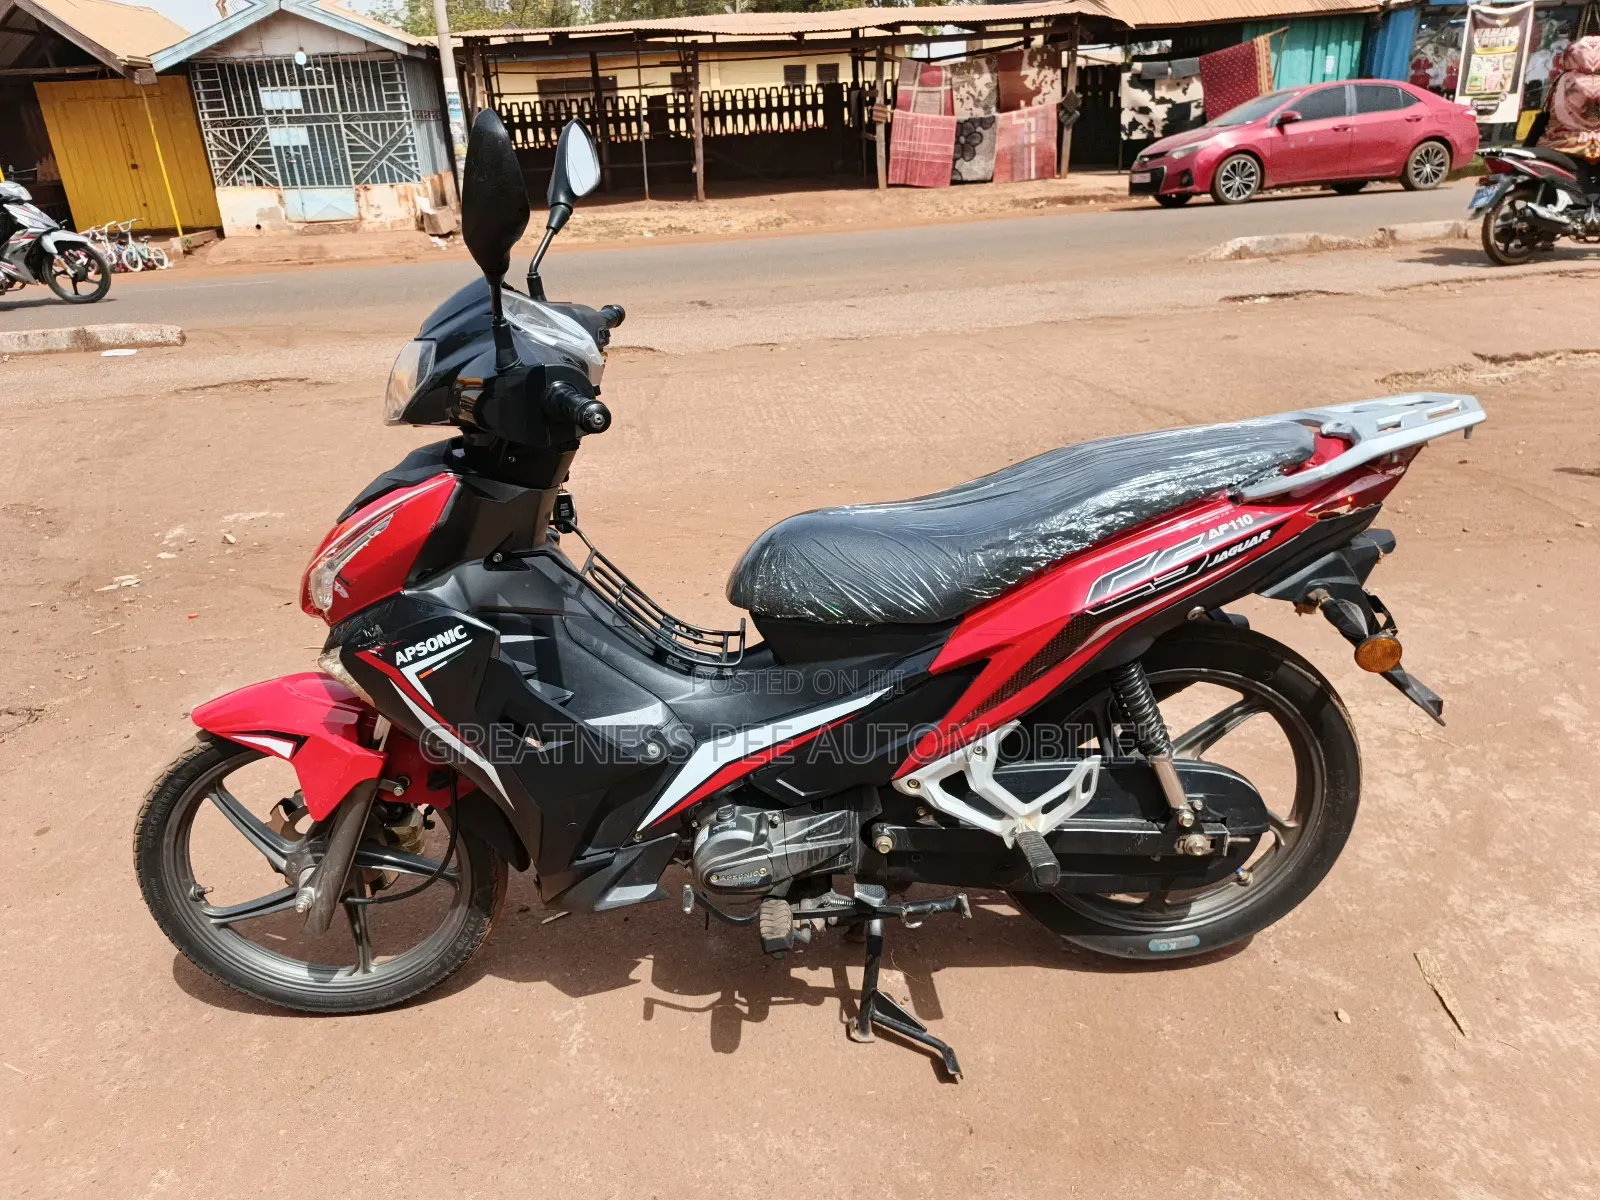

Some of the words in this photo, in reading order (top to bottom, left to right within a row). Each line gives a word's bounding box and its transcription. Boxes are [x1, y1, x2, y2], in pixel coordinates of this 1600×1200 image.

[1208, 513, 1254, 540] AP110
[1206, 529, 1272, 568] JAGUAR
[395, 624, 468, 666] APSONIC
